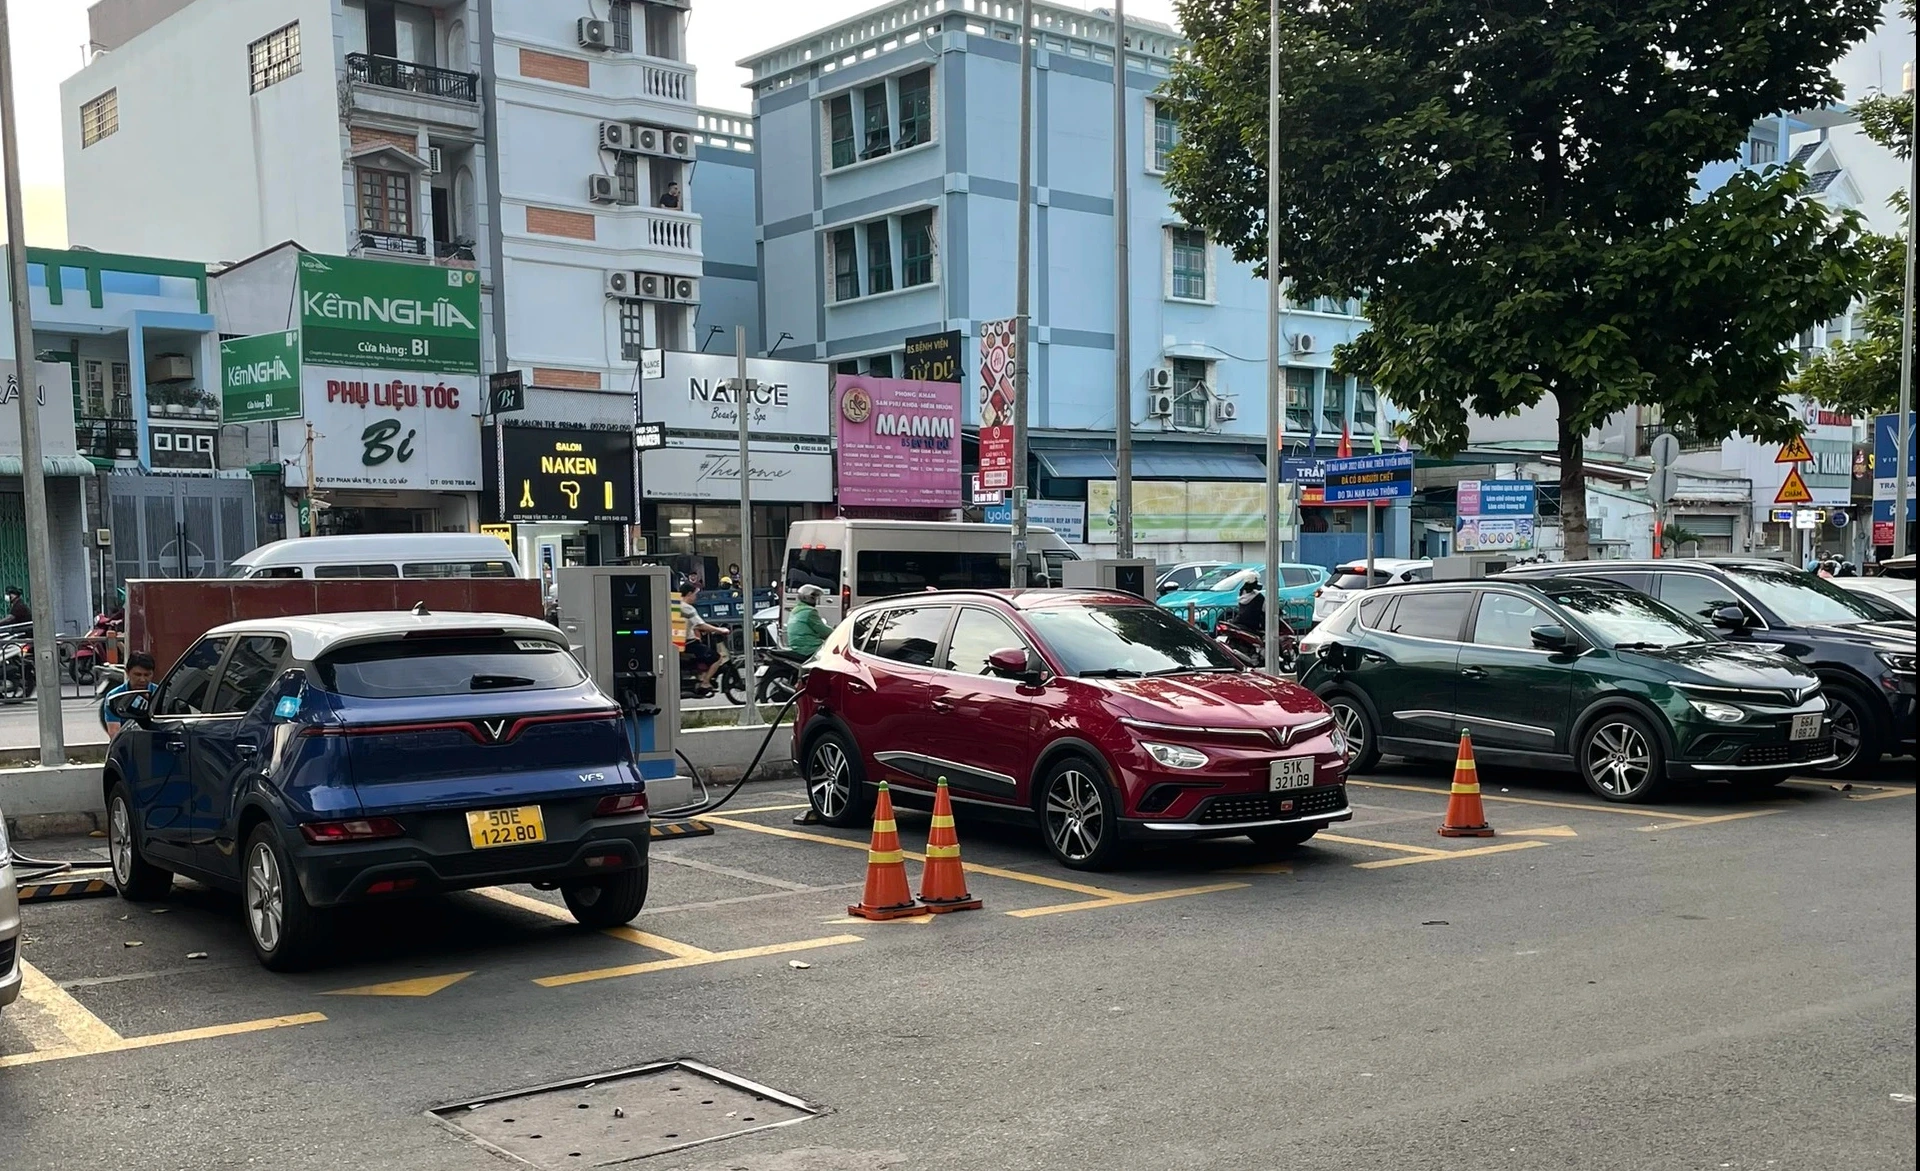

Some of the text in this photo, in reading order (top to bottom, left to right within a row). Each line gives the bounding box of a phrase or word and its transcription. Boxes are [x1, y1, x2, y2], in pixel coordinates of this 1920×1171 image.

[358, 338, 429, 357] Cửa hàng: BI
[266, 394, 272, 407] BI
[327, 379, 459, 410] PHỤ LIỆU TÓC
[497, 389, 515, 408] Bi
[754, 408, 766, 425] Spa
[876, 413, 954, 439] MAMMI
[361, 419, 416, 466] Bi
[555, 442, 582, 452] SALON
[541, 456, 597, 475] NAKEN
[1362, 472, 1379, 483] NGƯỜI
[1380, 470, 1394, 481] CHẾT
[1354, 489, 1366, 499] NẠN
[1366, 488, 1379, 497] GIAO
[1380, 486, 1398, 496] THÔNG
[1284, 761, 1302, 774] 51K
[579, 772, 604, 783] VF5
[1275, 774, 1309, 790] 321.09
[489, 809, 521, 827] 50E
[481, 825, 537, 845] 122.80
